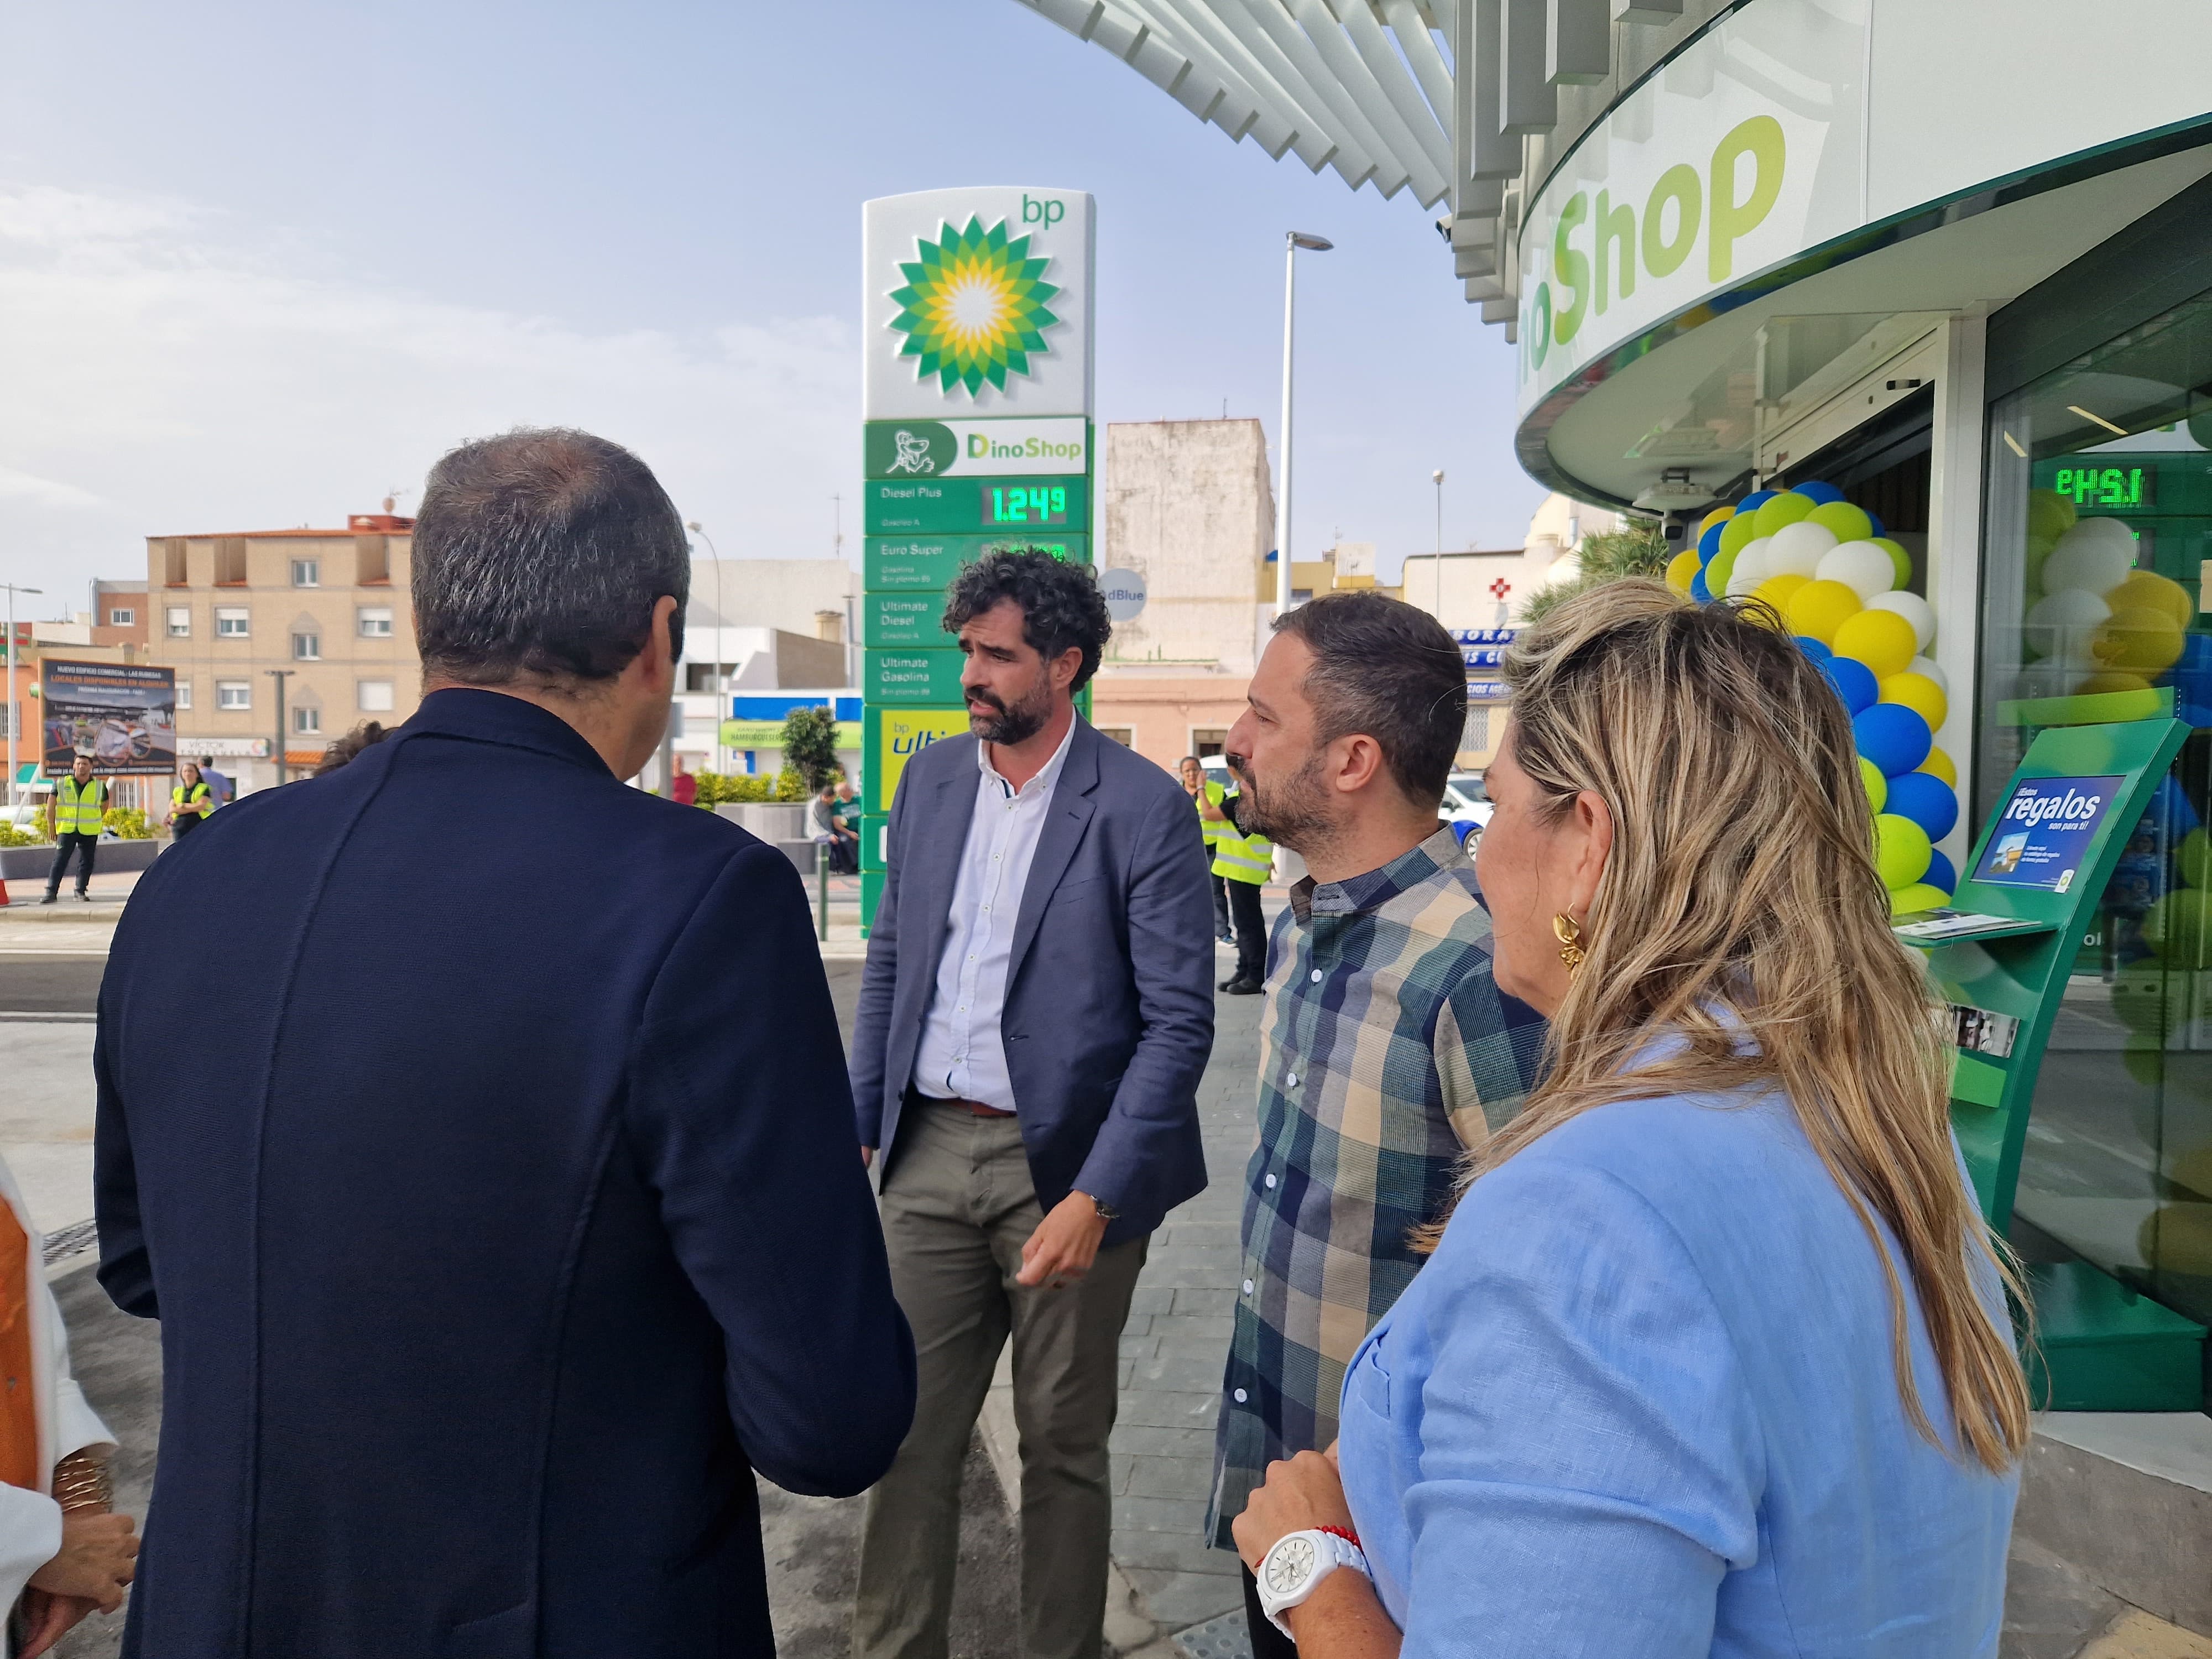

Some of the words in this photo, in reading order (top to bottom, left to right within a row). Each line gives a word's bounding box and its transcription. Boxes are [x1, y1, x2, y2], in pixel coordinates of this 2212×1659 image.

[1022, 194, 1065, 231] bp
[968, 433, 1082, 461] DinoShop
[881, 488, 915, 498] Diesel
[918, 487, 942, 498] Plus
[881, 545, 907, 555] Euro
[910, 544, 943, 556] Super
[881, 601, 928, 612] Ultimate
[881, 615, 914, 625] Diesel
[881, 658, 928, 667] Ultimate
[881, 670, 929, 682] Gasolina
[894, 721, 909, 734] bp
[2005, 788, 2101, 827] regalos
[2062, 822, 2079, 832] para
[2079, 821, 2089, 830] ti!
